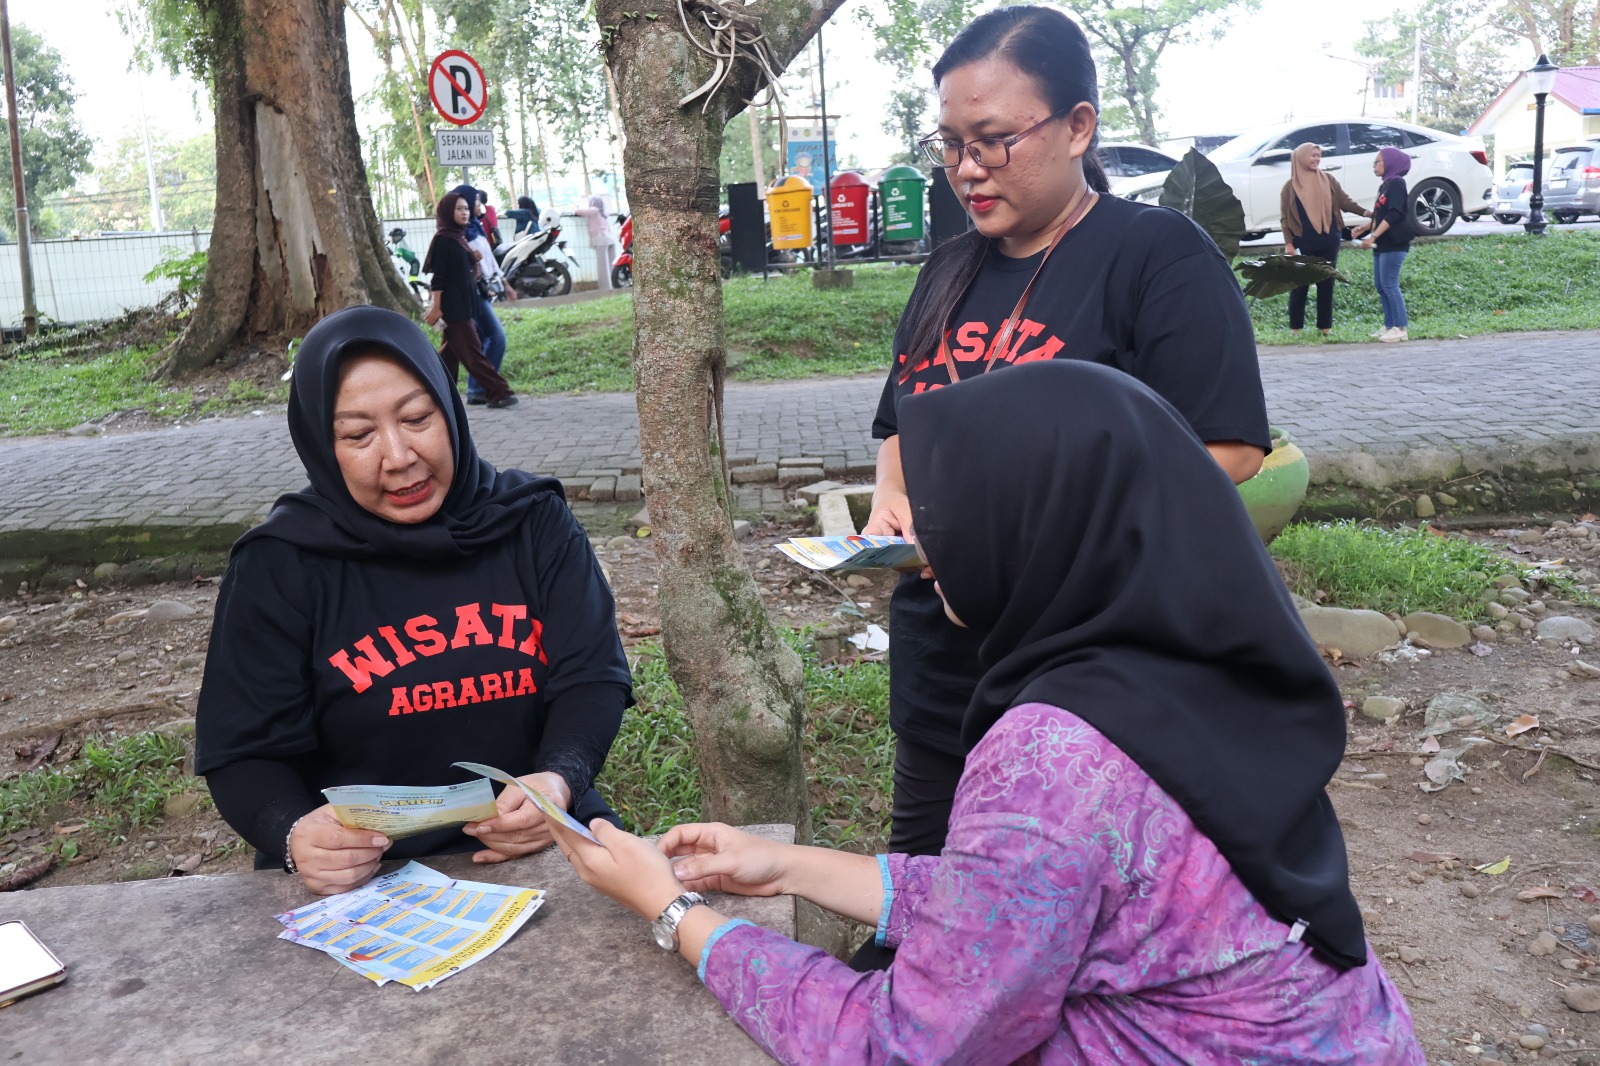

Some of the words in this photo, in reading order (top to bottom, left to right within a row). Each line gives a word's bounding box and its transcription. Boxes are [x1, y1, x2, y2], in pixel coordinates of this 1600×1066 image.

[449, 65, 472, 114] P
[441, 135, 490, 146] SEPANJANG
[447, 149, 472, 161] JALAN
[475, 150, 487, 160] INI
[328, 602, 548, 694] WISATA
[388, 668, 538, 716] AGRARIA
